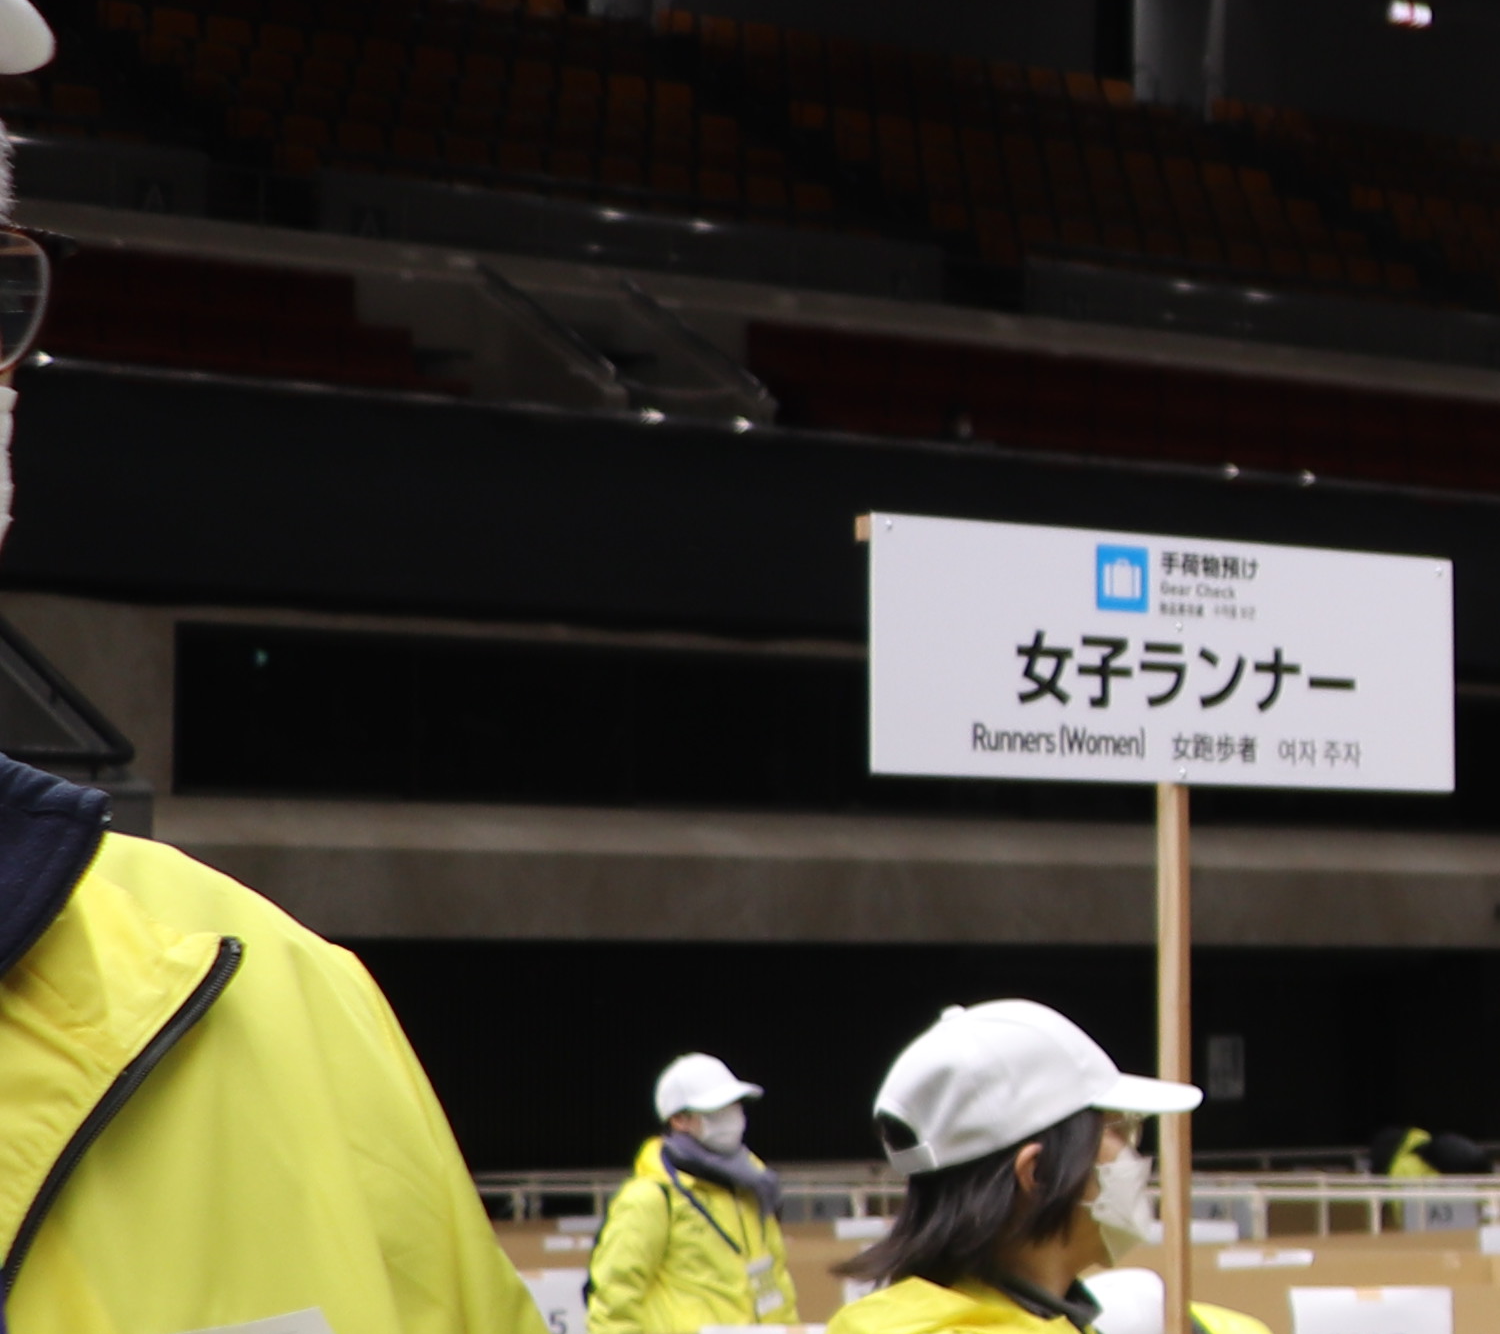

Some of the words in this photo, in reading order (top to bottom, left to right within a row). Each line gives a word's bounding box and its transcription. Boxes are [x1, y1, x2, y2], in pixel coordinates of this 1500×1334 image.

[1016, 630, 1356, 712] 女子ランナー
[971, 722, 1056, 754] Runners
[1059, 726, 1147, 760] (Women)
